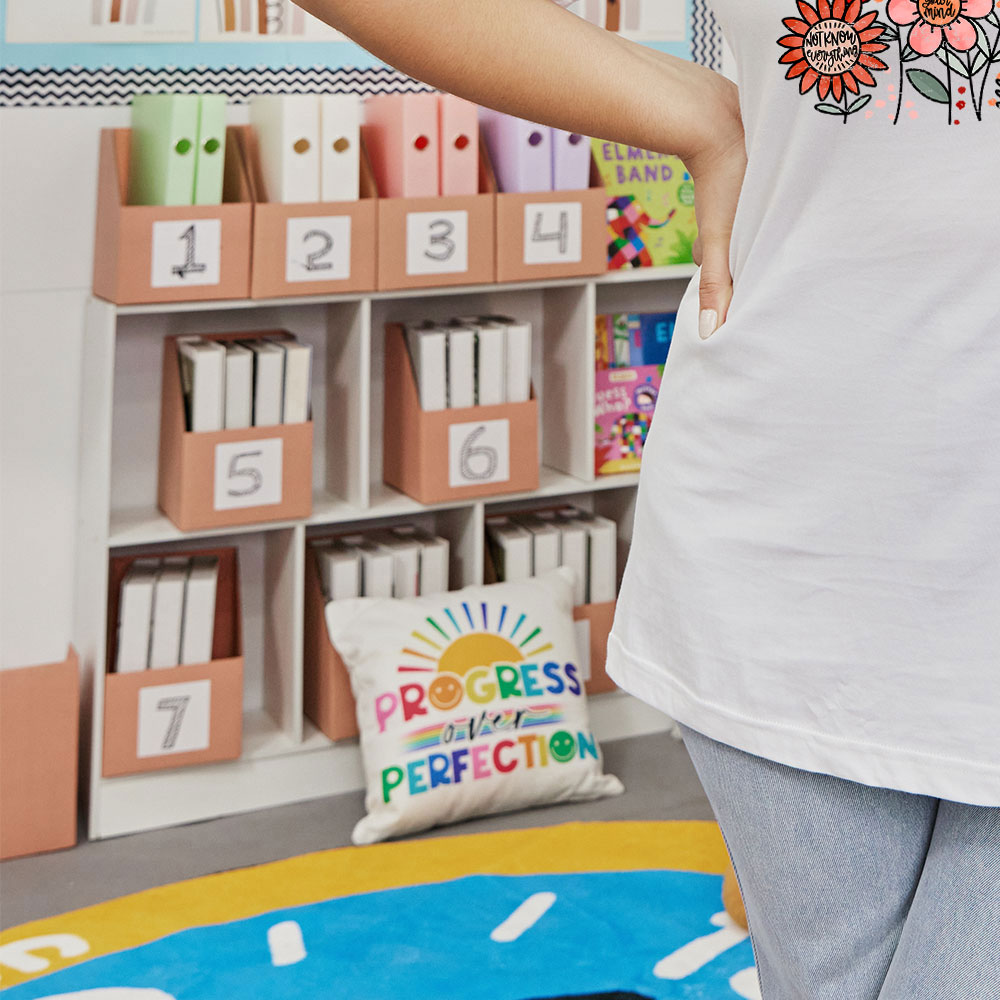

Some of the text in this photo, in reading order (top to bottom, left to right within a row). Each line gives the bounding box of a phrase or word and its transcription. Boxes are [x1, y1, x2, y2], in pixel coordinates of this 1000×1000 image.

[923, 6, 957, 20] mind
[616, 164, 673, 184] BAND
[171, 224, 207, 279] 1
[300, 229, 334, 271] 2
[423, 218, 456, 261] 3
[531, 210, 568, 255] 4
[228, 451, 263, 497] 5
[460, 424, 498, 481] 6
[155, 694, 192, 749] 7
[443, 708, 540, 744] over
